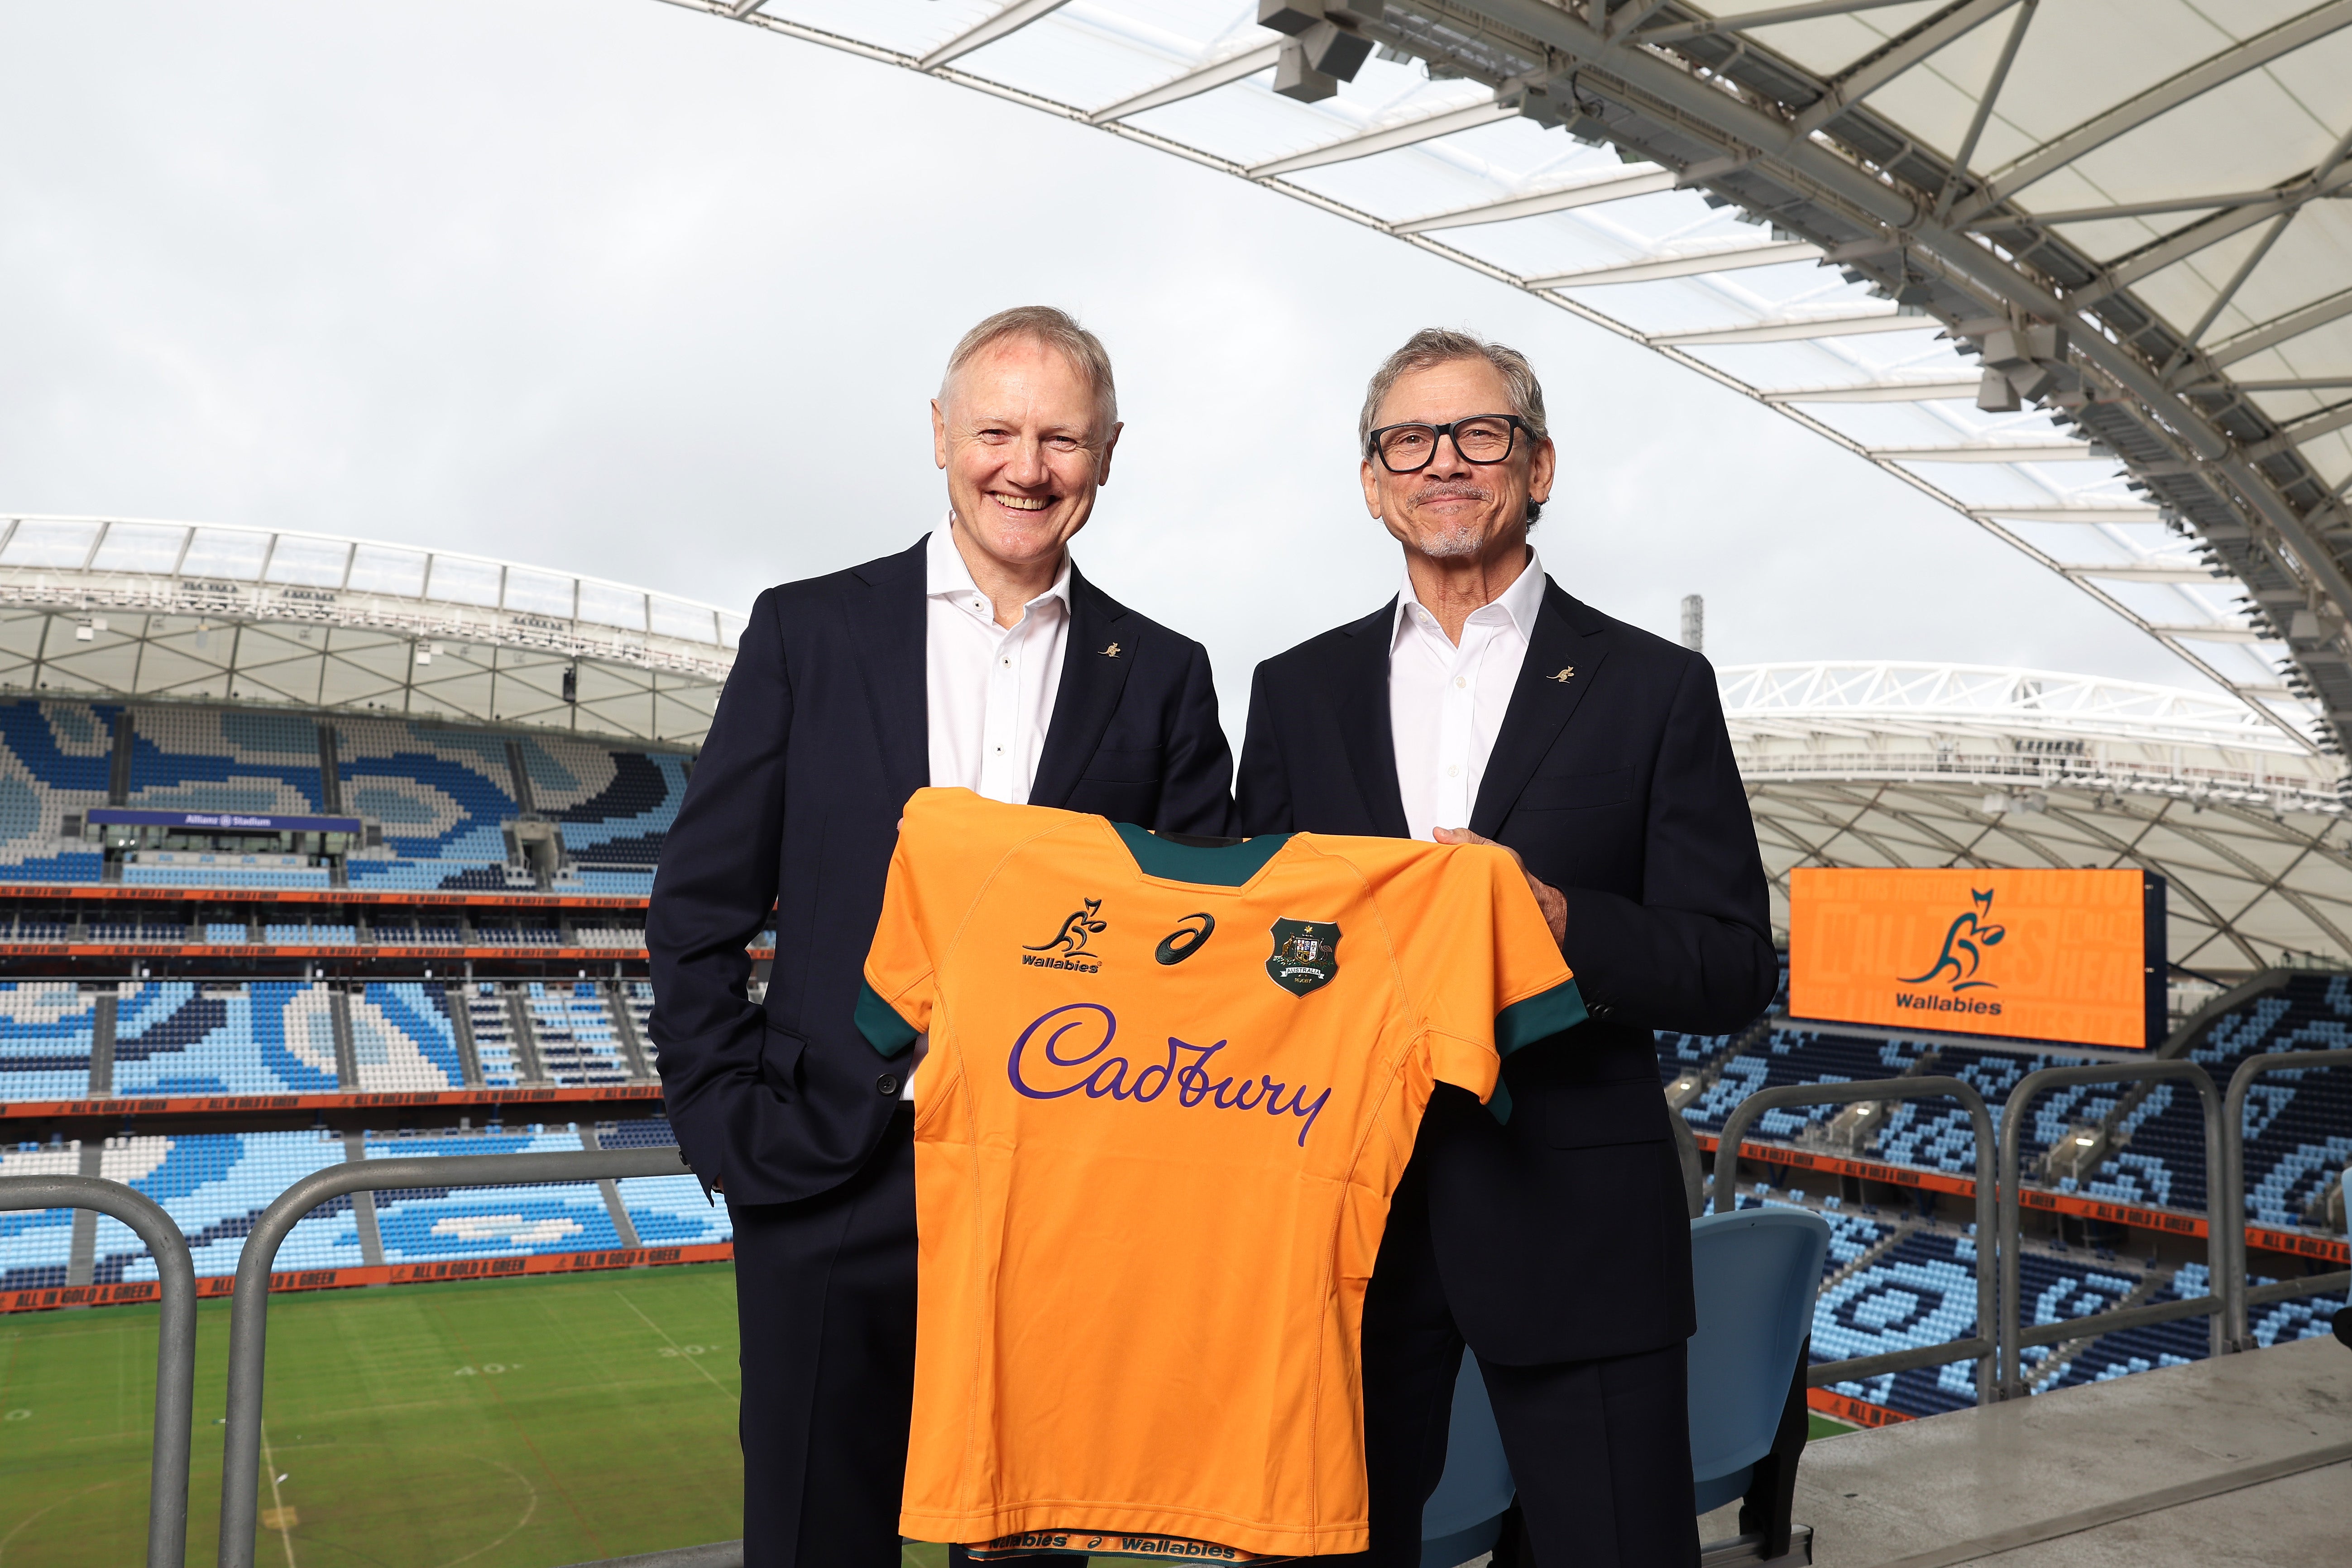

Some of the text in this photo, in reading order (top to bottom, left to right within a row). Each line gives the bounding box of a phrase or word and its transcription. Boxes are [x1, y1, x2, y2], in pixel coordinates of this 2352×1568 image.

[233, 816, 271, 827] Stadium
[1896, 993, 2001, 1015] Wallabies
[1008, 1003, 1332, 1147] Cadbury
[15, 1293, 37, 1307] ALL
[43, 1291, 57, 1305] IN
[62, 1288, 97, 1304] GOLD
[114, 1285, 154, 1299] GREEN
[1122, 1538, 1235, 1558] Wallabies
